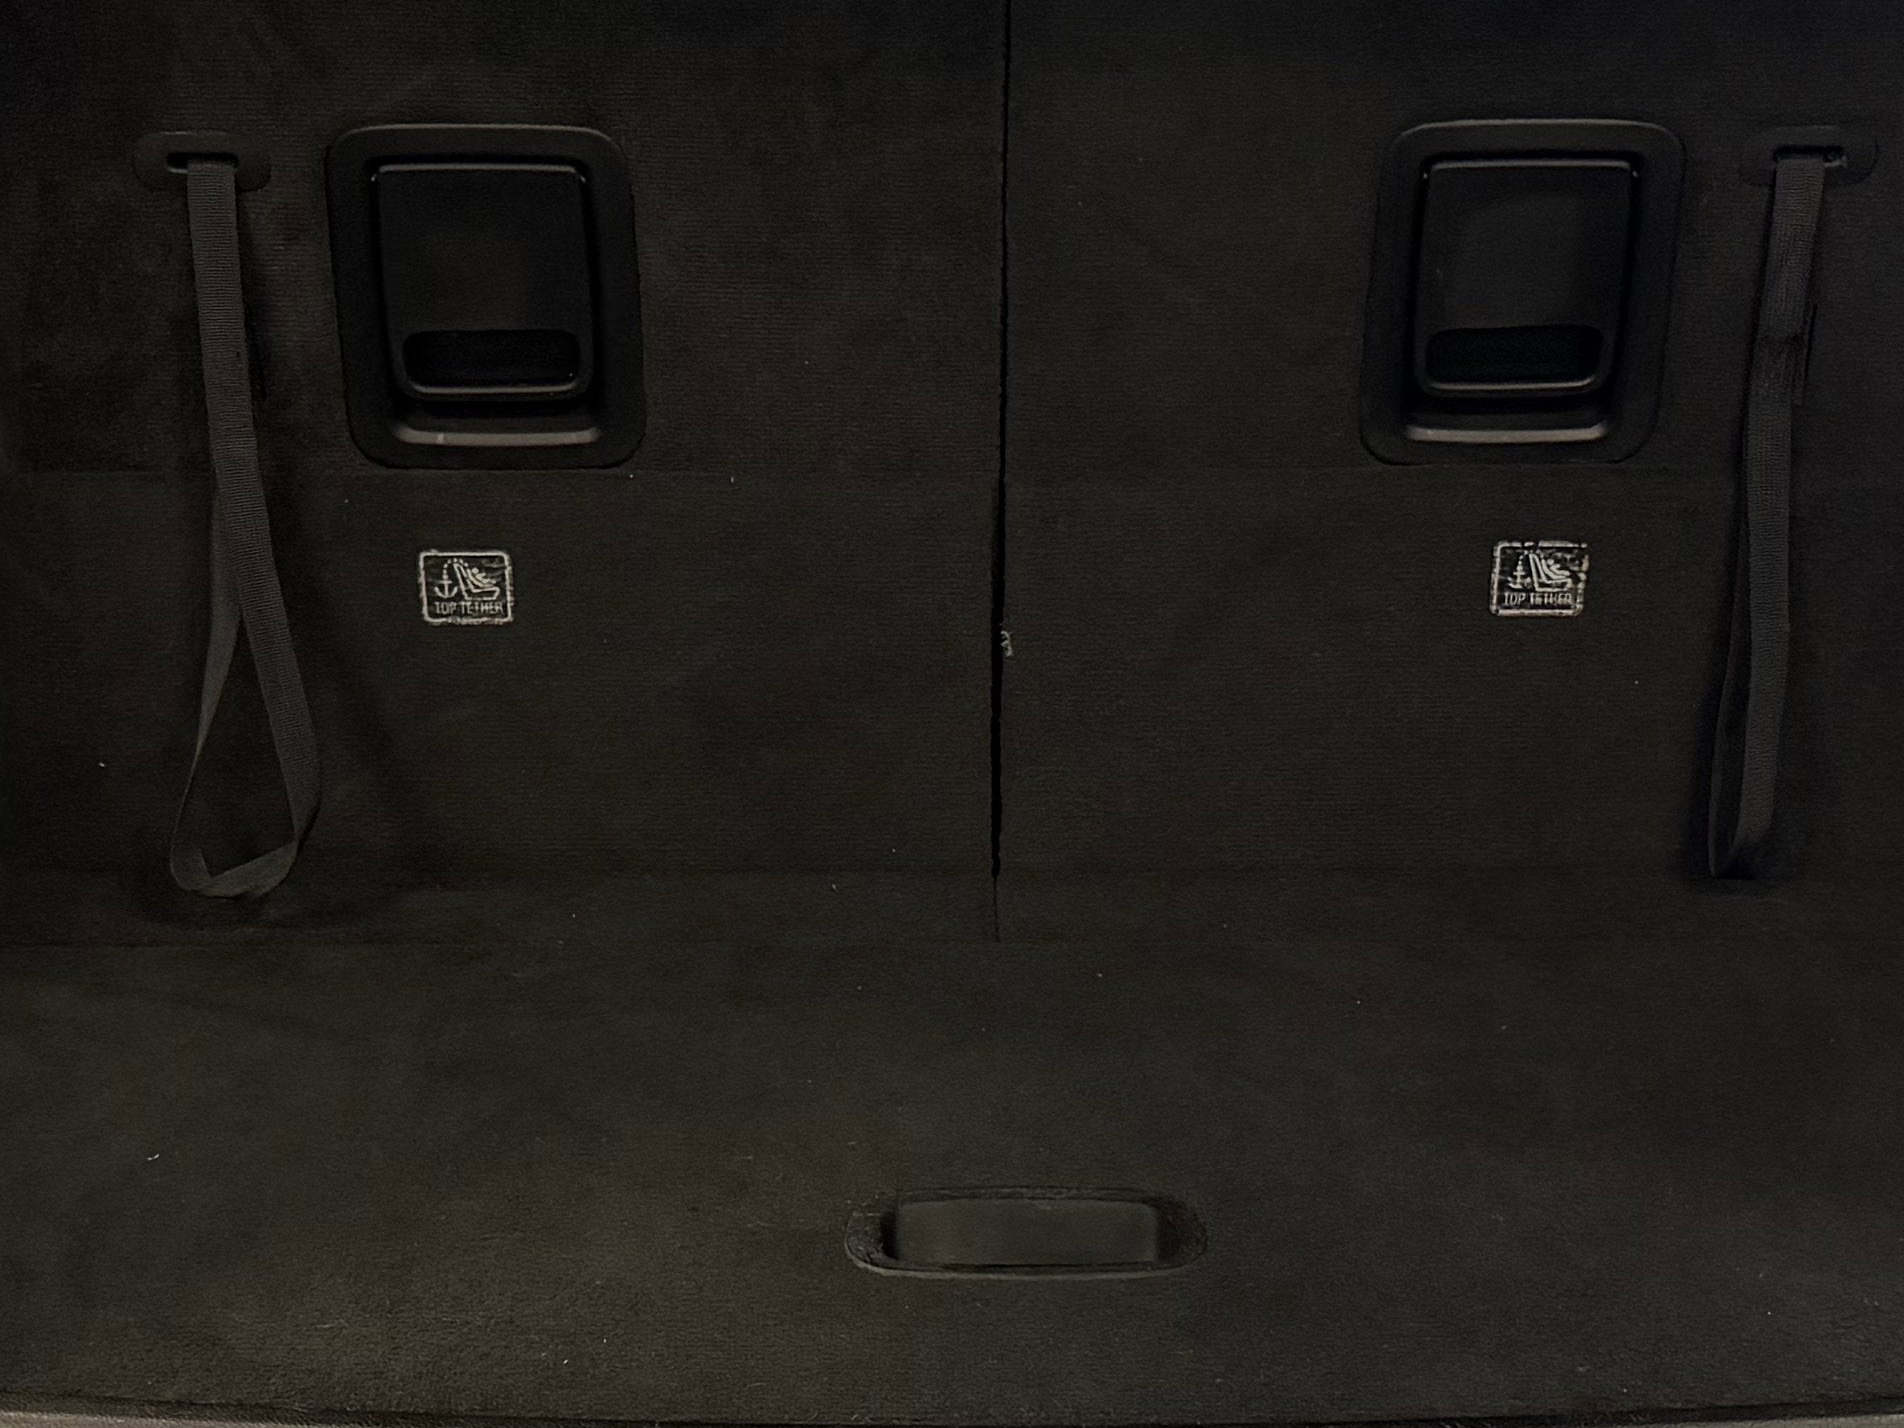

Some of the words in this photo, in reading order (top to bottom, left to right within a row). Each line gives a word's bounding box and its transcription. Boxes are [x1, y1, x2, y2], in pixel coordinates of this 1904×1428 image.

[1504, 592, 1526, 605] TOP
[435, 601, 457, 614] TOP
[459, 601, 504, 614] TETHER
